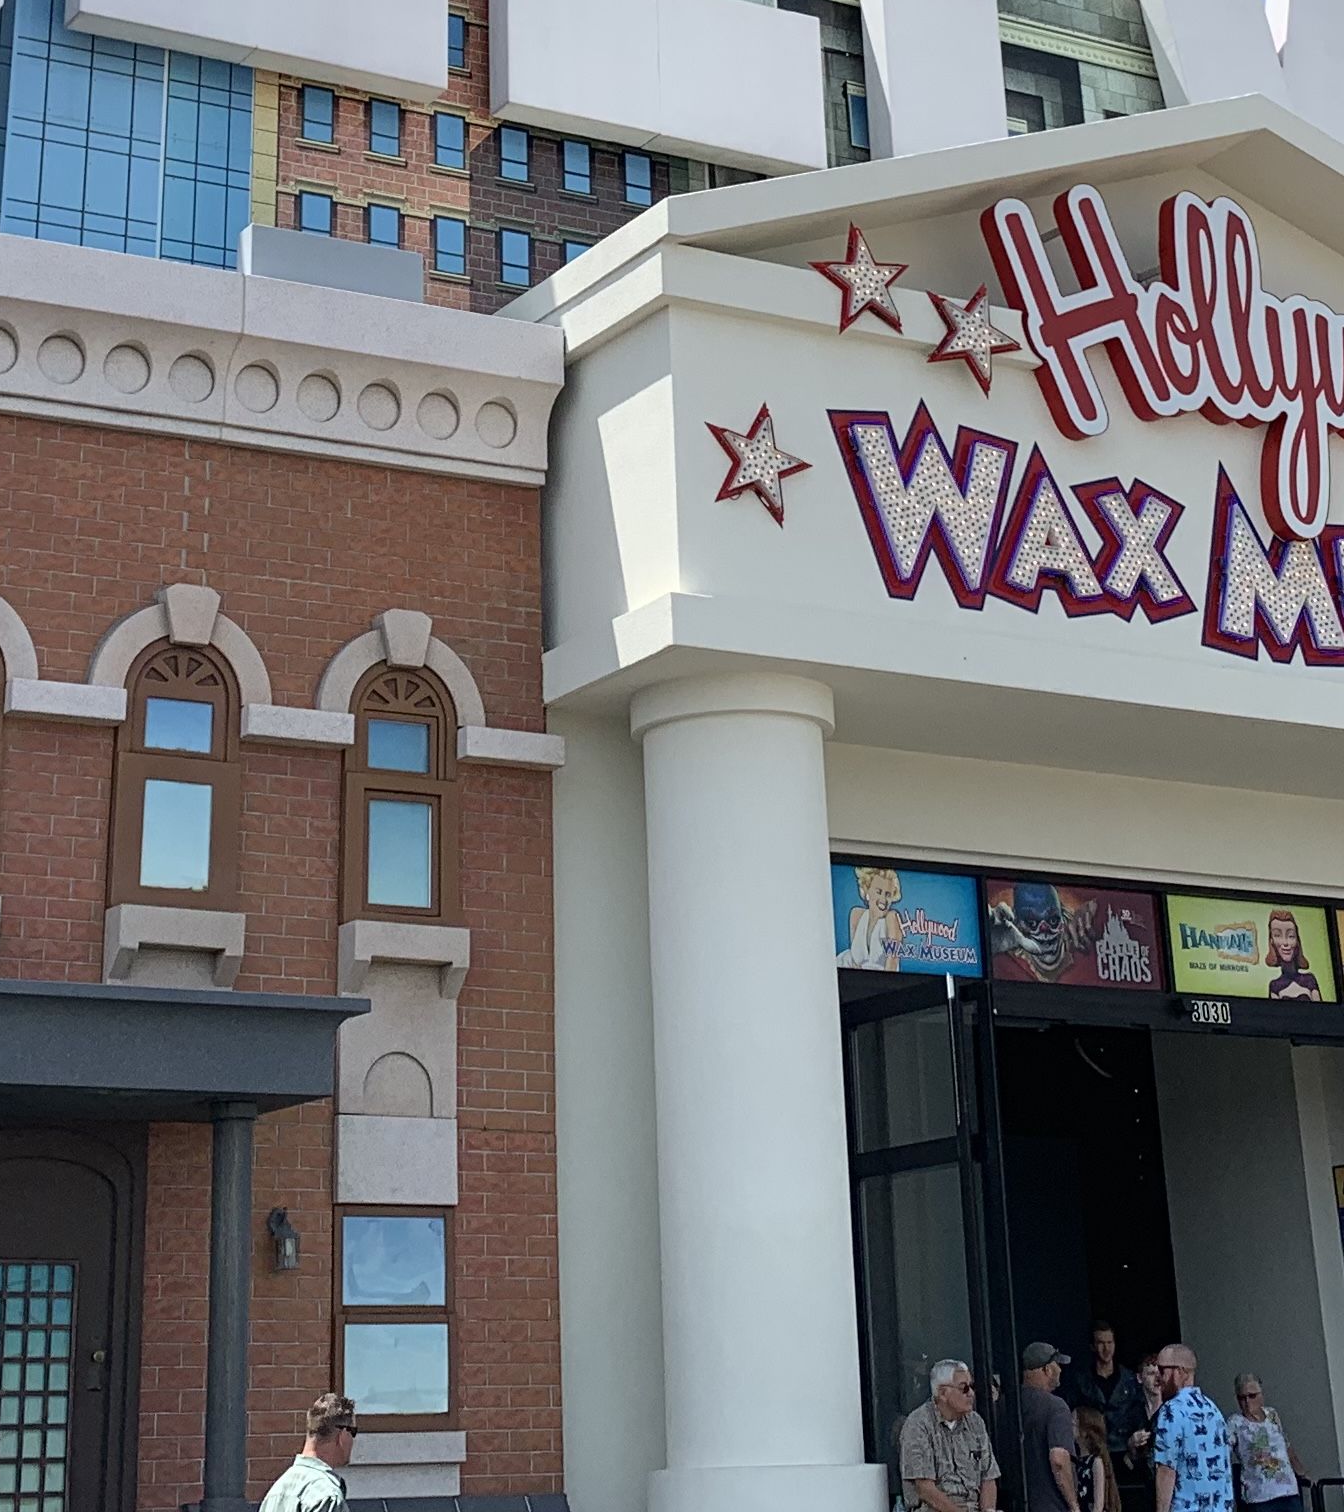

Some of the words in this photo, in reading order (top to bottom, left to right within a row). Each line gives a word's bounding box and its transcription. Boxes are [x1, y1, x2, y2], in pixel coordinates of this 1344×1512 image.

[826, 397, 1198, 626] WAX
[896, 908, 959, 946] Hollywood
[882, 937, 915, 959] WAX
[919, 944, 978, 964] MUSEUM
[1097, 955, 1152, 983] CHAOS
[1192, 1001, 1230, 1023] 3030
